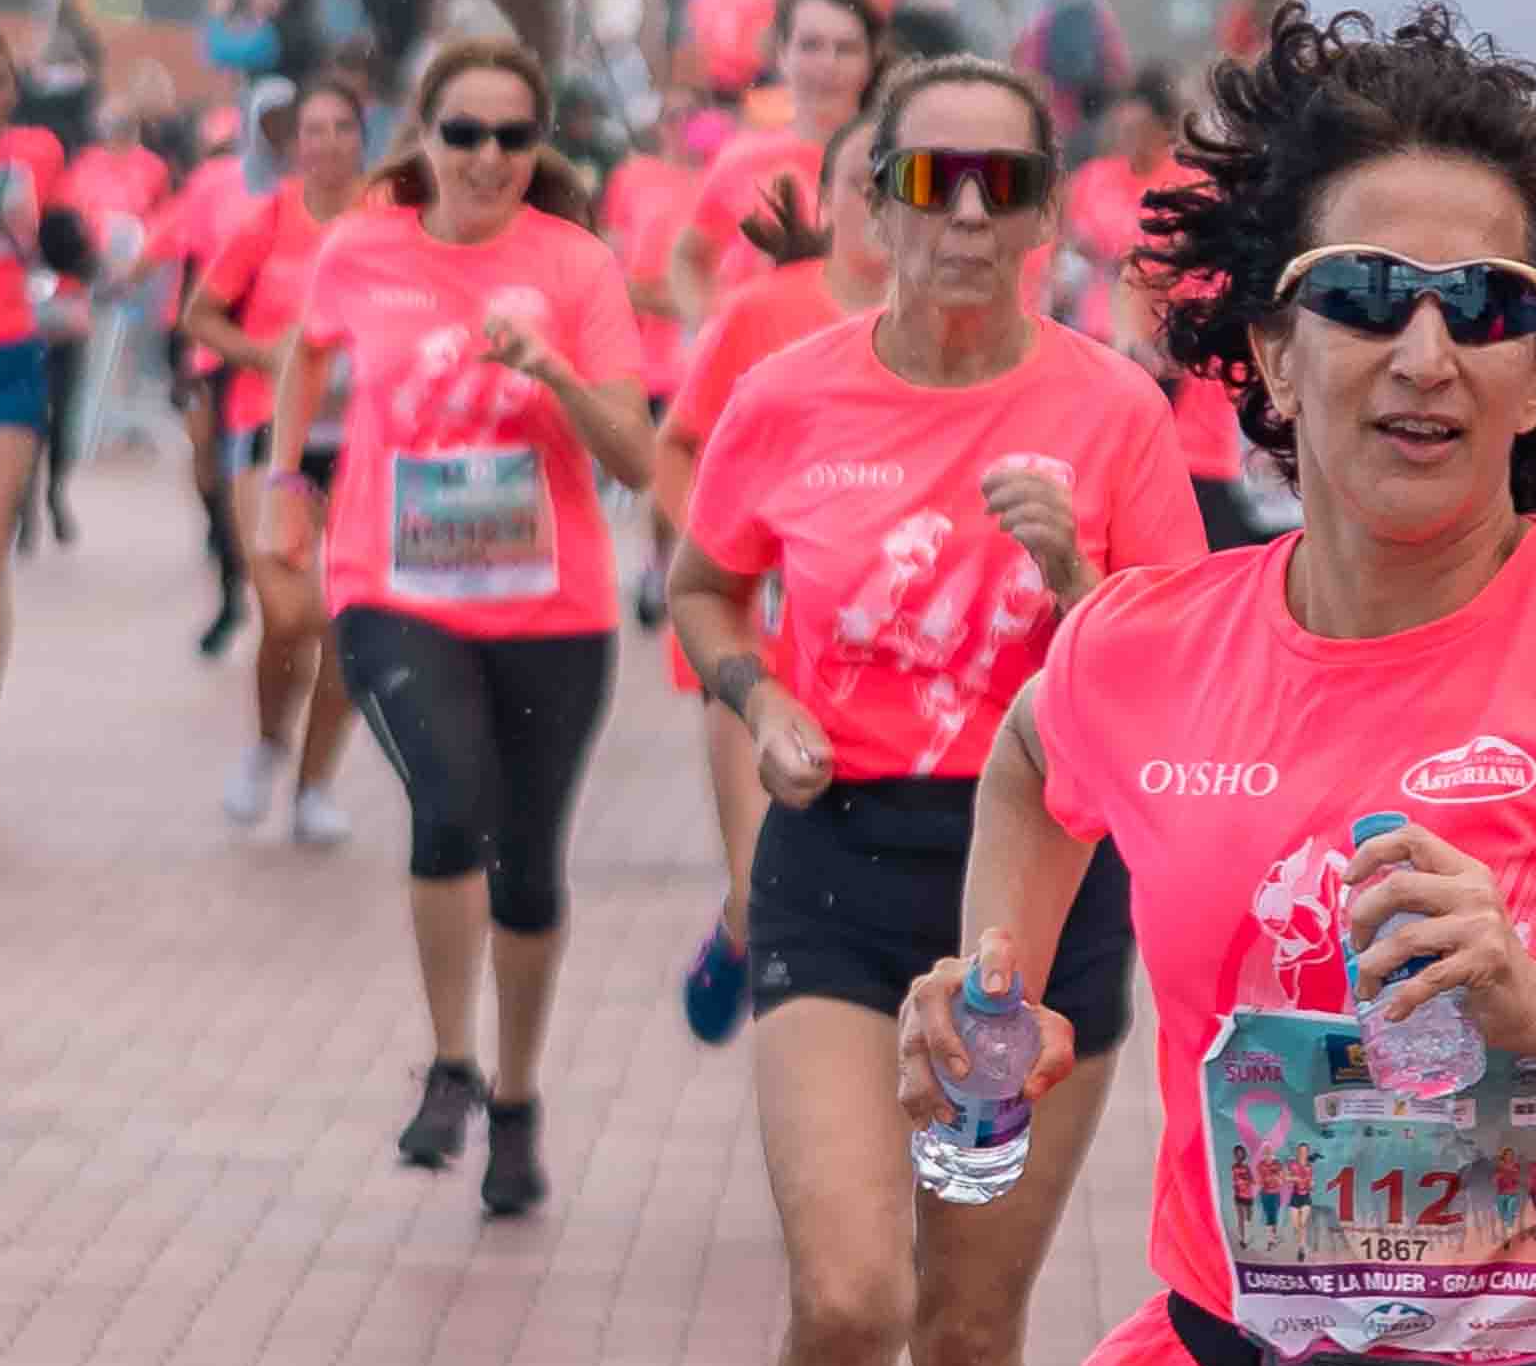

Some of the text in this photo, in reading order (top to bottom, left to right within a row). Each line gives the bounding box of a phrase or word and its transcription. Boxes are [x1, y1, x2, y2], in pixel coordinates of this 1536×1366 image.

[1138, 758, 1279, 798] OYSHO
[1325, 1165, 1465, 1227] 112
[1359, 1237, 1429, 1262] 1867
[1311, 1273, 1335, 1293] DE
[1338, 1274, 1361, 1293] LA
[1365, 1272, 1427, 1294] MUJER
